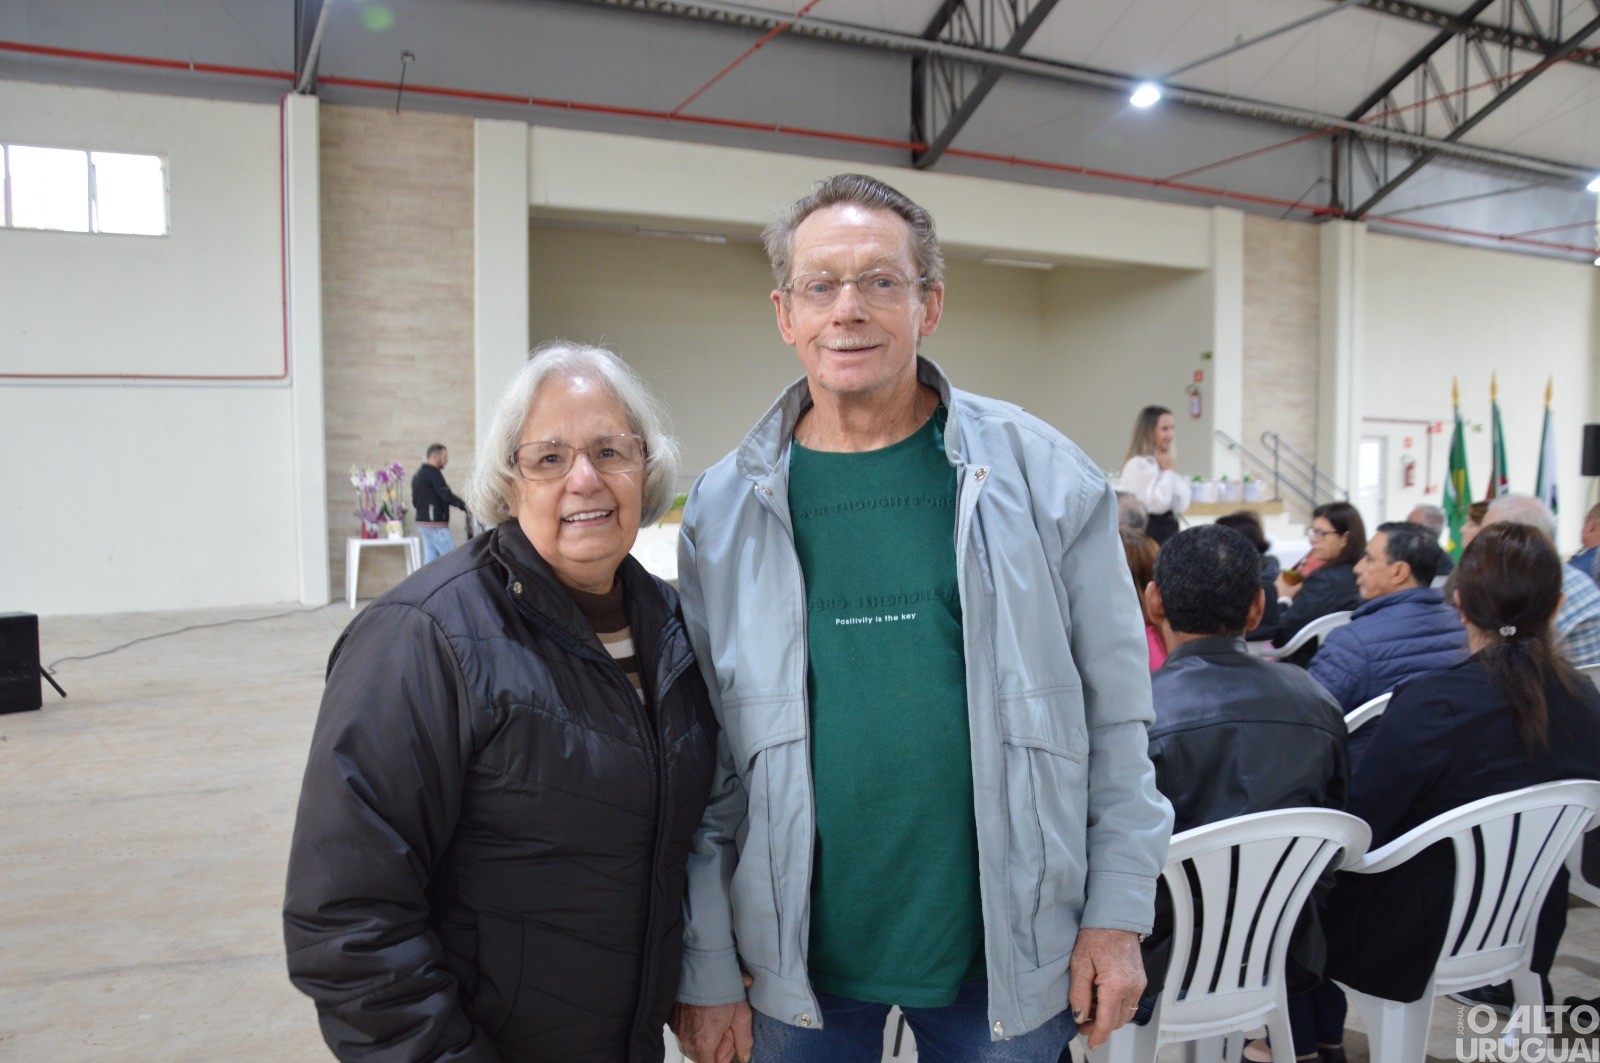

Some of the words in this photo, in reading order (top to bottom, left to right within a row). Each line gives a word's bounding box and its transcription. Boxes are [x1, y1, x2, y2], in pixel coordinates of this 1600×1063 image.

[834, 495, 920, 514] THOUGHTS
[835, 614, 873, 626] Positivity
[884, 614, 899, 622] the
[901, 612, 916, 621] key
